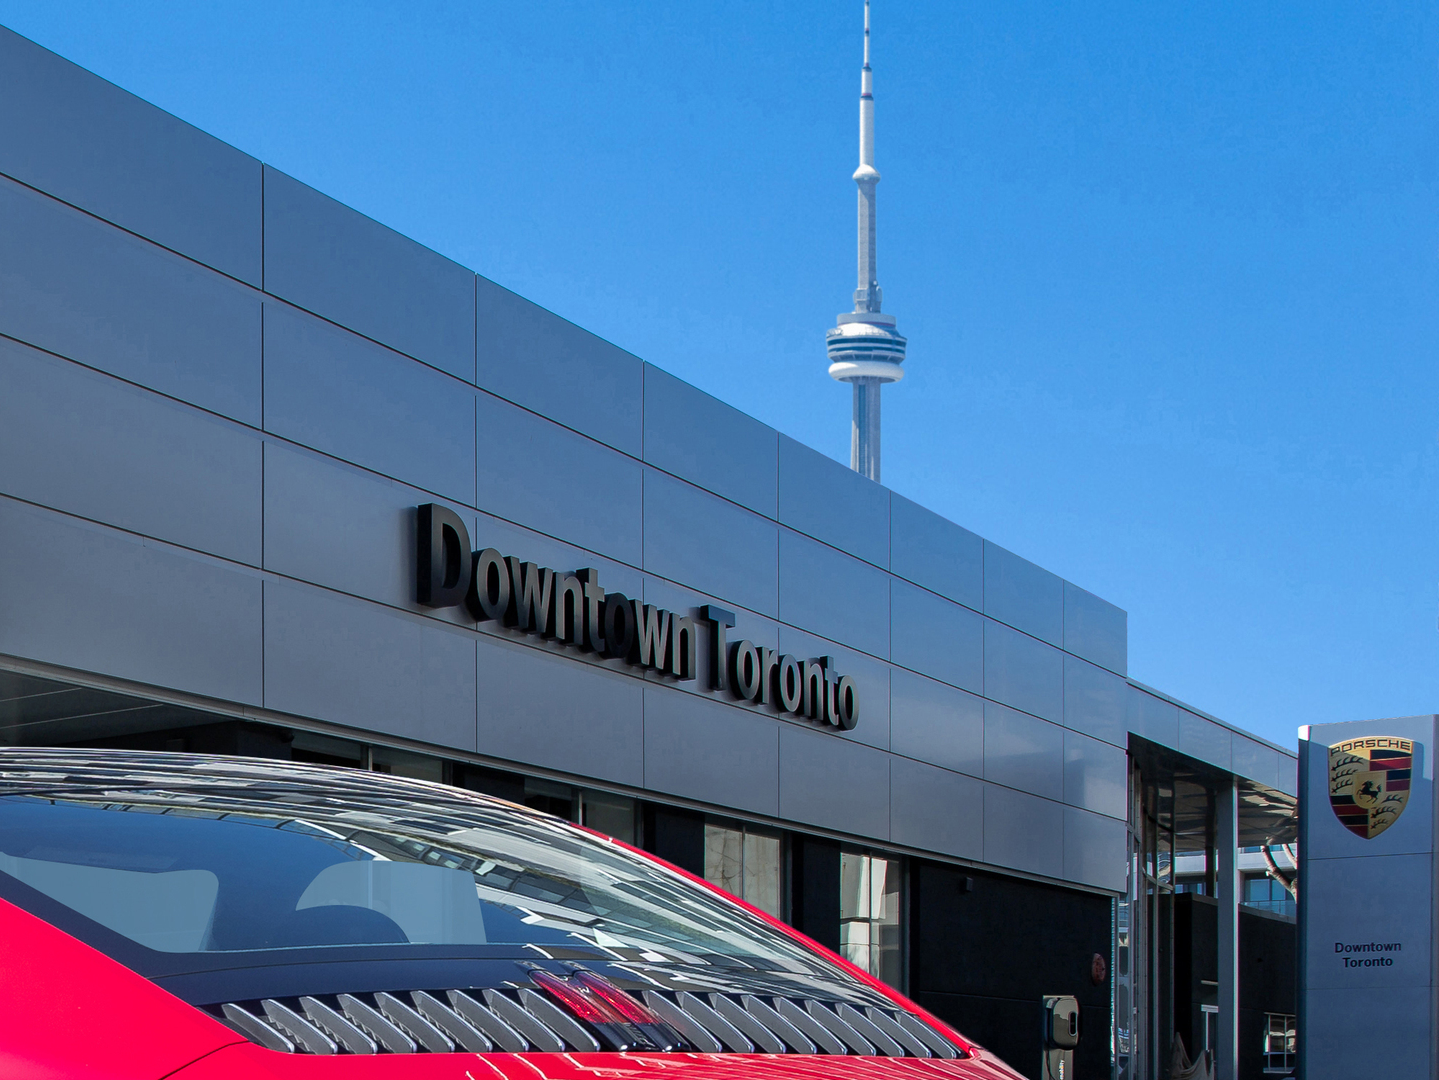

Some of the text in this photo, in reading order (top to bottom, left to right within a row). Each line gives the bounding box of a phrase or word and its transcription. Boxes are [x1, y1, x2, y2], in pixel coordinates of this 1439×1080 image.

[417, 502, 860, 732] Downtown Toronto
[1330, 739, 1411, 756] PORSCHE
[1335, 942, 1402, 953] Downtown
[1342, 957, 1393, 968] Toronto
